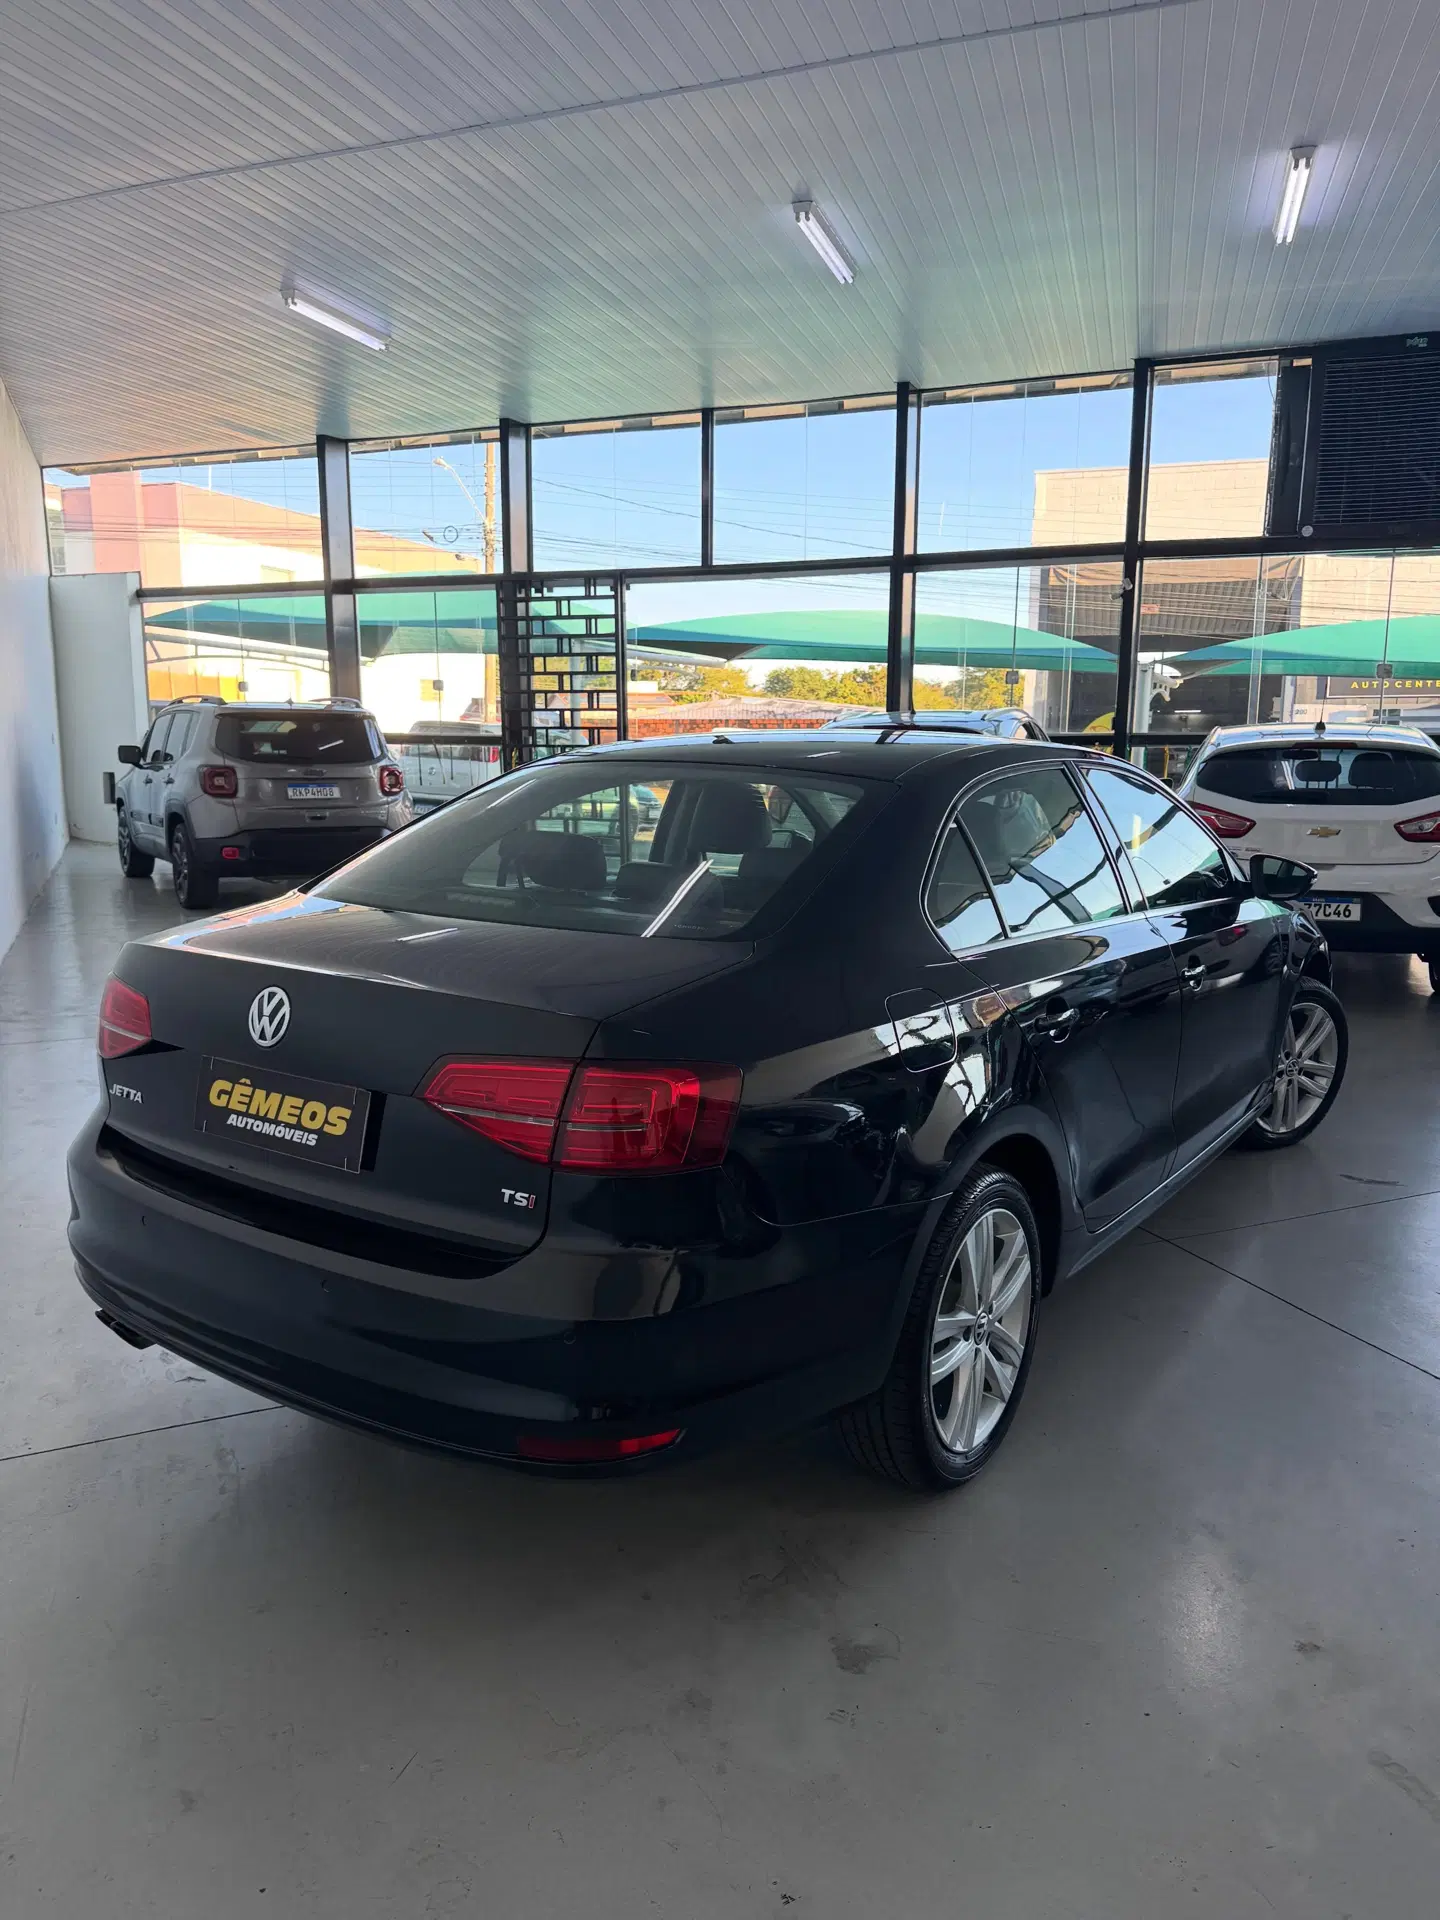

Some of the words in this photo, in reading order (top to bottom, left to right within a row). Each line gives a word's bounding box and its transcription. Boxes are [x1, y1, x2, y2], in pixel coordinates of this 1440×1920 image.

[1350, 680, 1390, 689] AUTO
[1394, 679, 1440, 688] CENTE
[248, 986, 291, 1047] VW
[109, 1083, 142, 1104] JETTA
[208, 1077, 352, 1136] GÊMEOS
[226, 1113, 319, 1147] AUTOMÓVEIS
